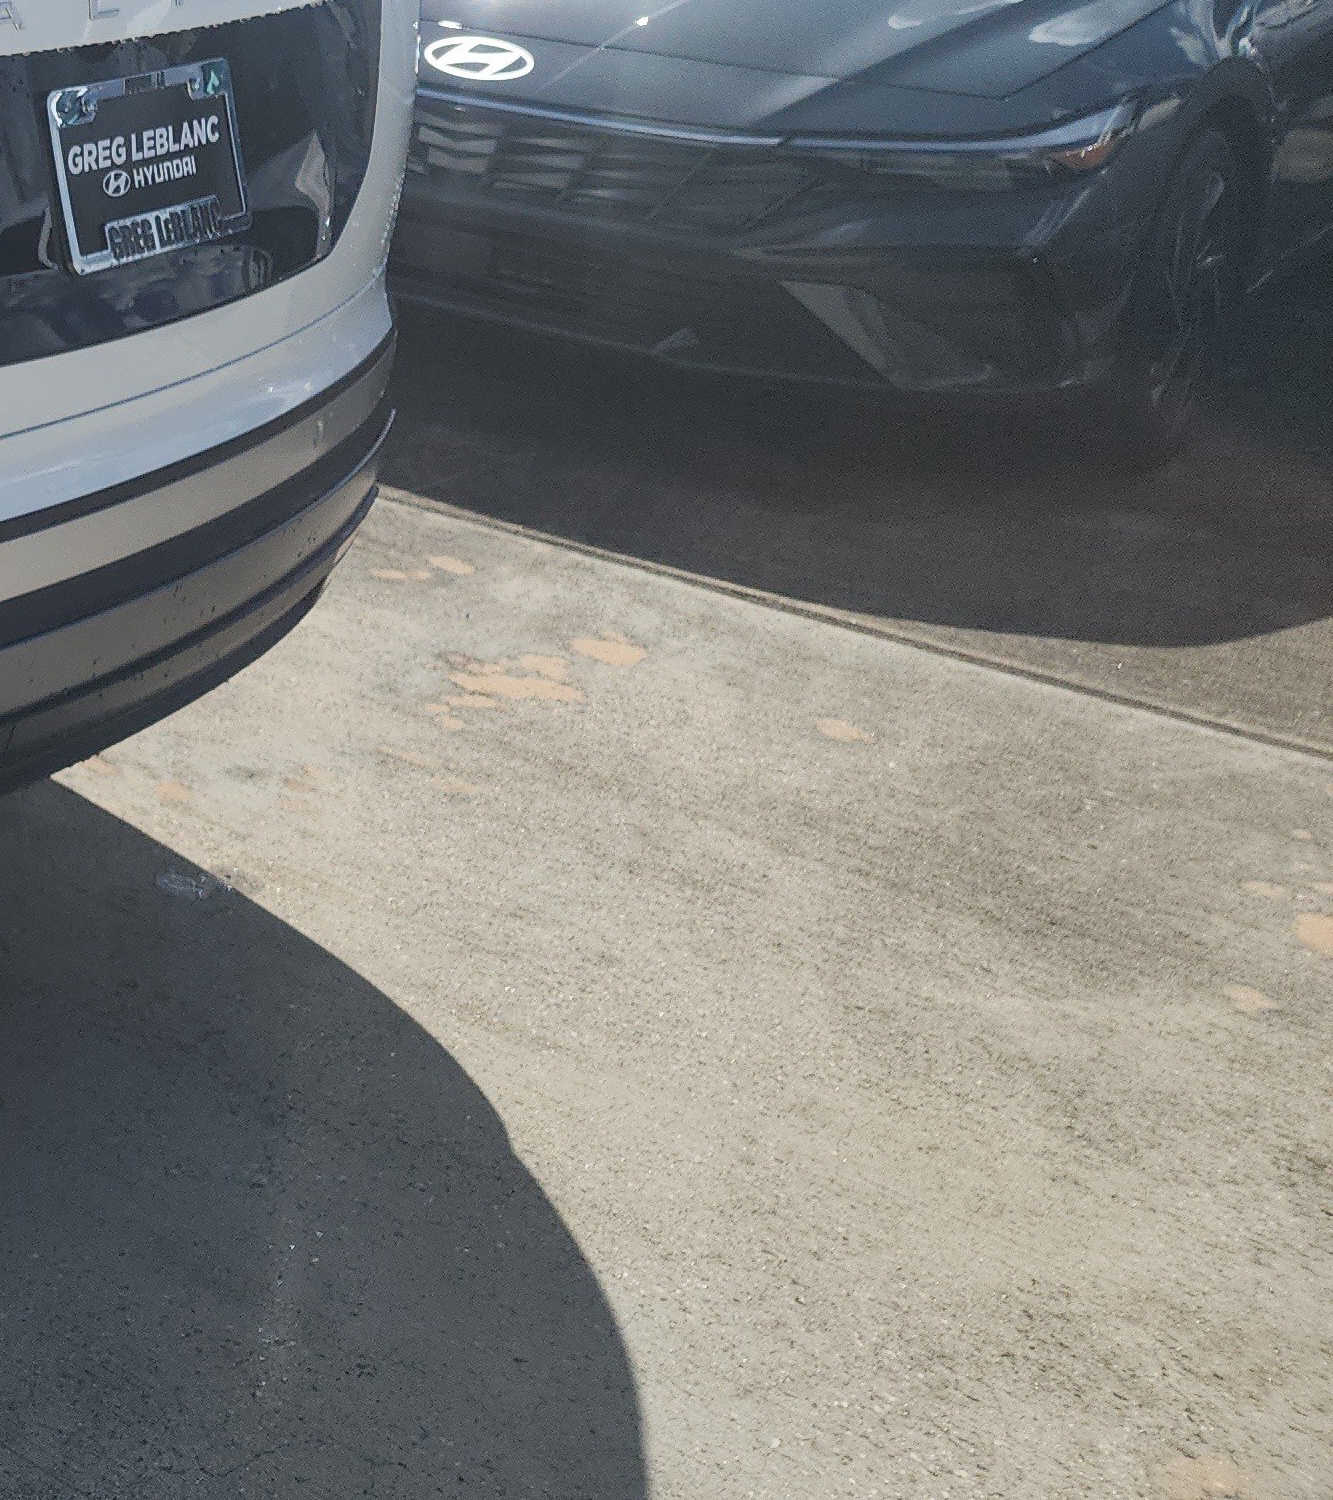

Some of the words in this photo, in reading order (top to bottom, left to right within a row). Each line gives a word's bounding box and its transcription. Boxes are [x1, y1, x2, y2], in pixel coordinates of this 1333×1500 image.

[68, 136, 127, 175] GREG
[131, 115, 220, 161] LEBLANC
[133, 155, 197, 189] HYUNDAI
[108, 218, 156, 261] GREG
